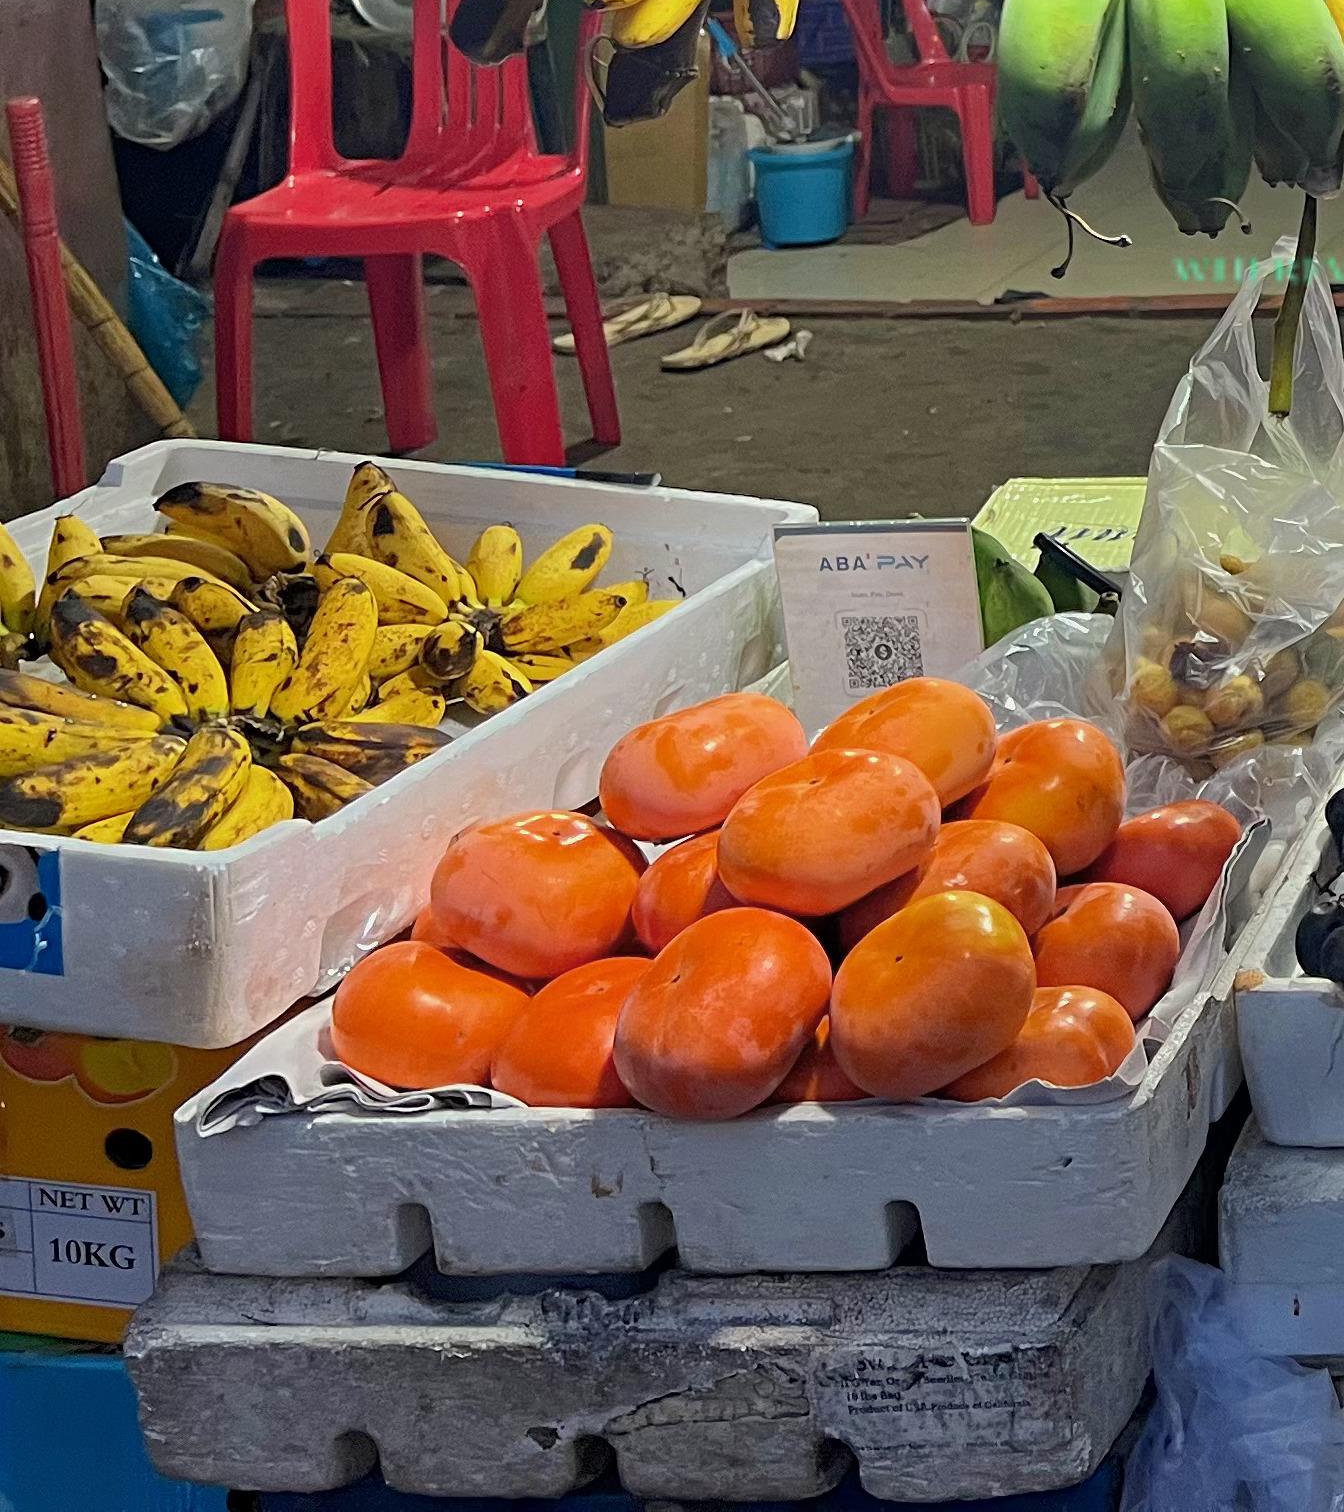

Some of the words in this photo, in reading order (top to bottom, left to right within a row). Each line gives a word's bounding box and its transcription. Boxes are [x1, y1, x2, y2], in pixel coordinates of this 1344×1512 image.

[876, 555, 929, 570] PAY
[39, 1189, 92, 1211] NET
[102, 1194, 146, 1216] WT
[49, 1237, 136, 1270] 10KG
